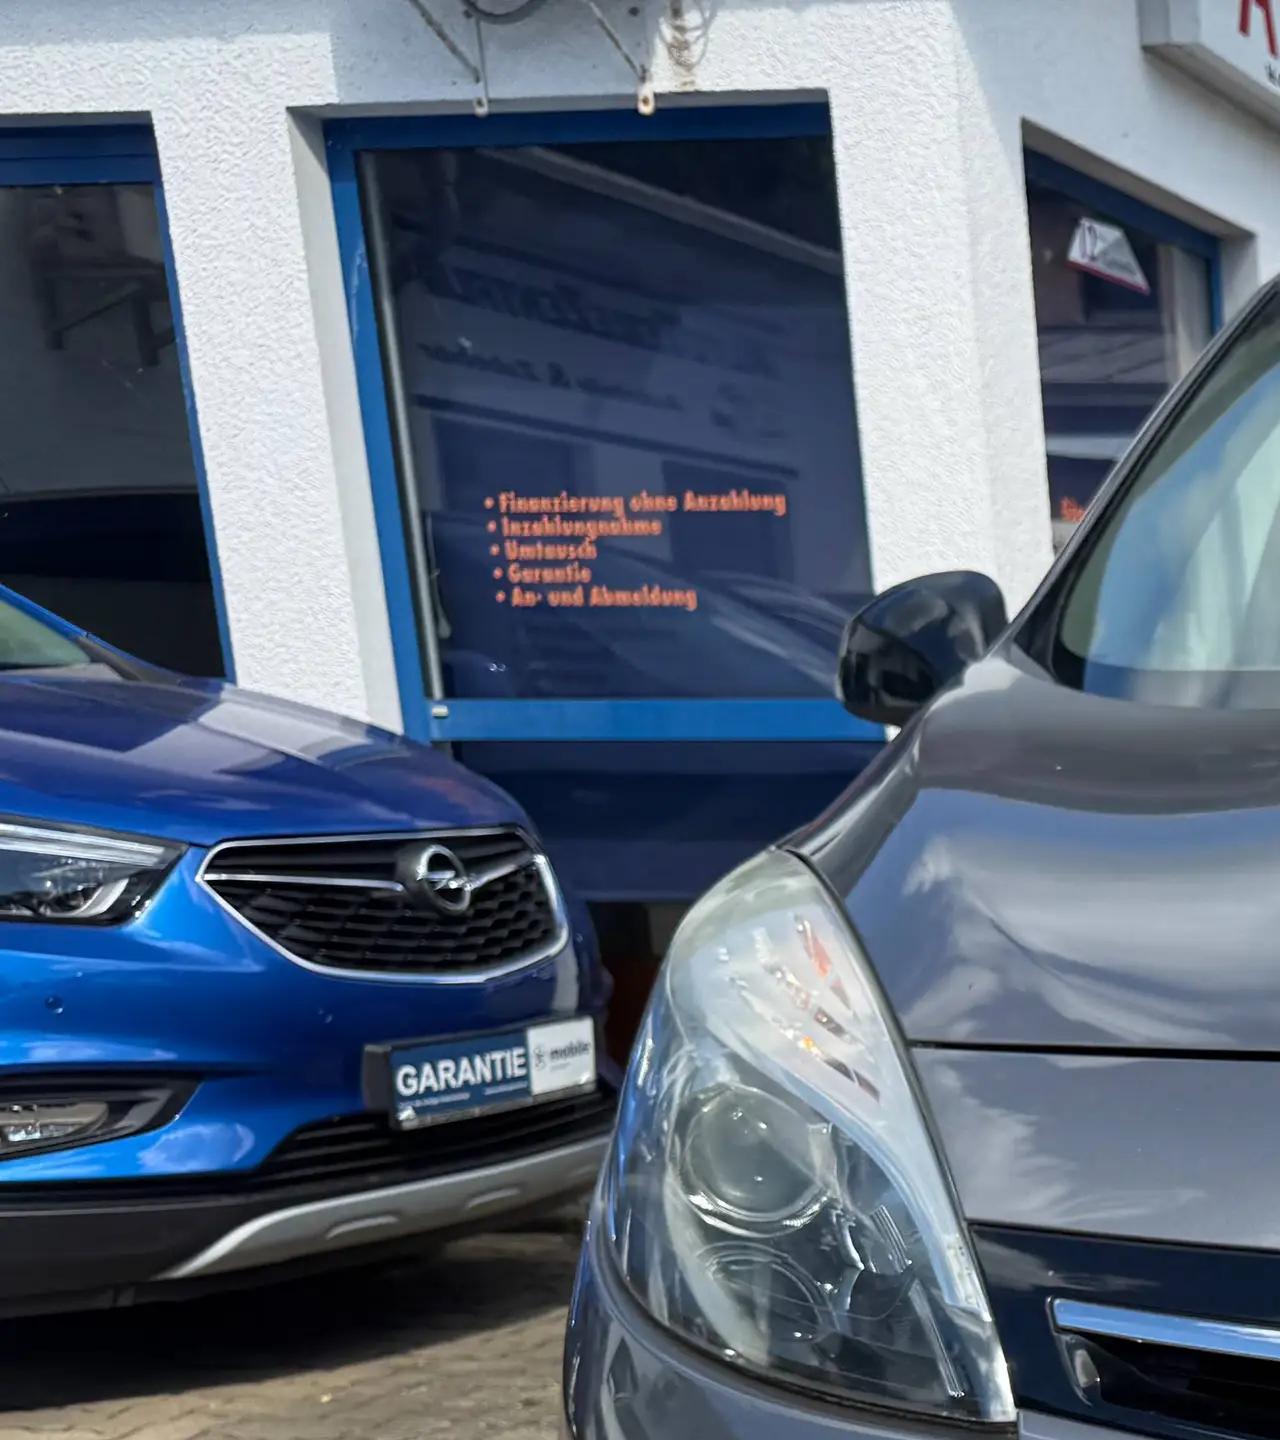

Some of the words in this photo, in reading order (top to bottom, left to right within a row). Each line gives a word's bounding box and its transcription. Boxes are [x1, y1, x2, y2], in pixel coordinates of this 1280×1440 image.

[499, 490, 625, 519] Finanzierung
[629, 489, 678, 512] ohne
[683, 488, 787, 516] Anzahlung
[502, 515, 663, 542] Inzahlungnahme
[504, 537, 598, 560] Umtausch
[508, 562, 592, 584] Garantie
[547, 584, 584, 607] und
[590, 584, 698, 612] Abmeldung
[396, 1046, 528, 1097] GARANTIE
